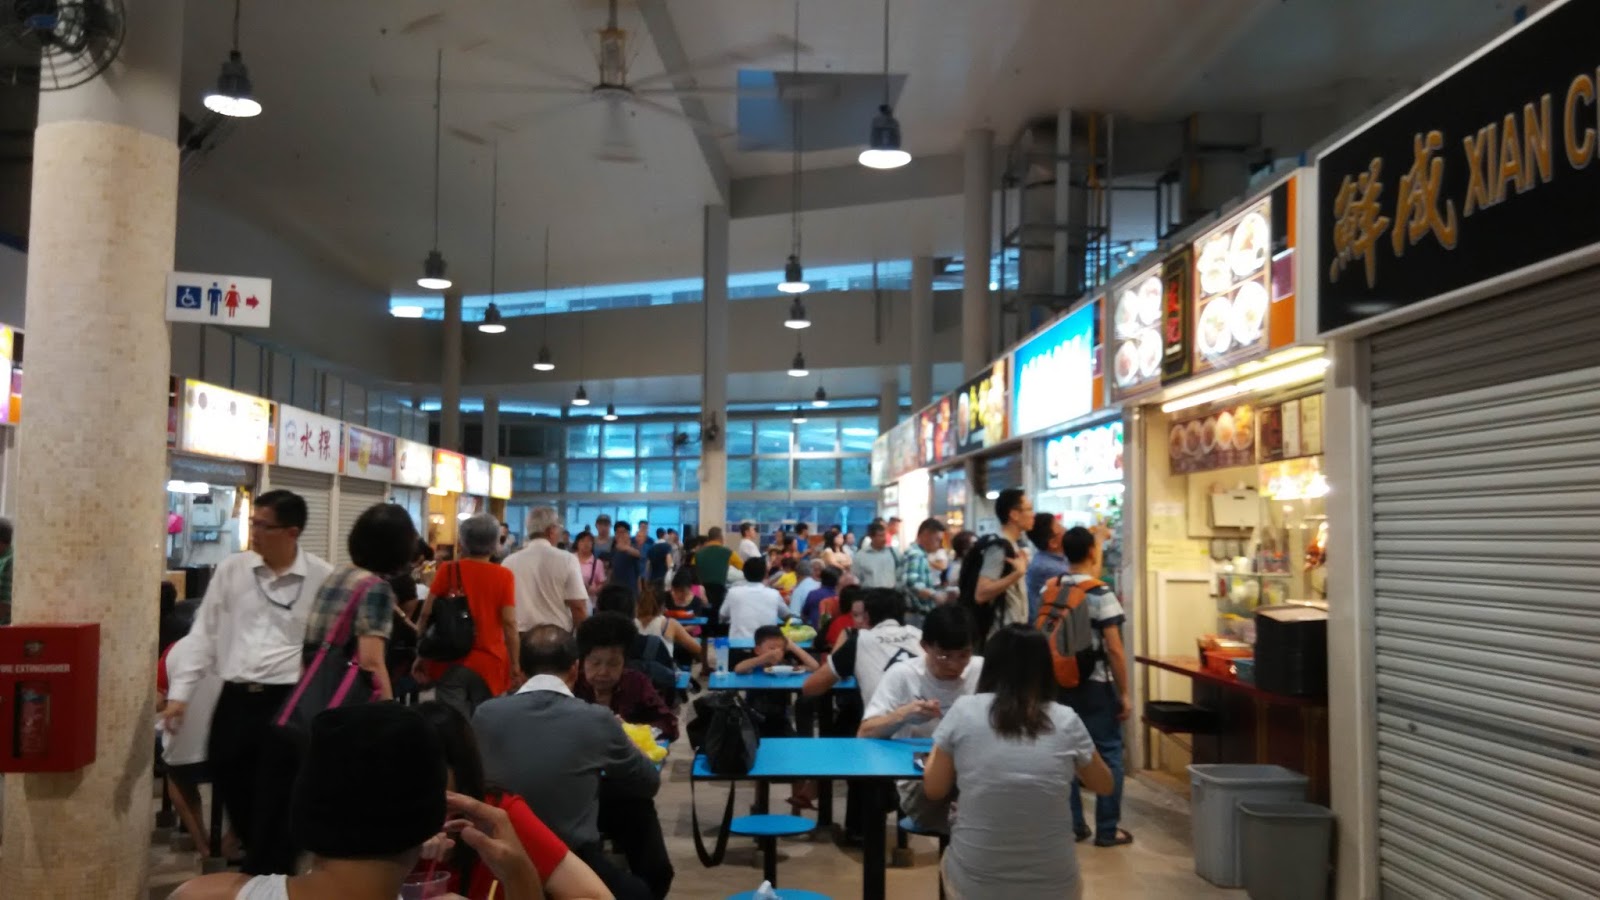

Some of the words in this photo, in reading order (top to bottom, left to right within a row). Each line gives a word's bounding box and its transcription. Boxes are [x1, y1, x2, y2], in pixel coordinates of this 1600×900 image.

[1463, 93, 1551, 218] XIAN
[1563, 65, 1600, 170] C
[0, 664, 13, 673] IRE
[15, 663, 71, 673] EXTINGUISHER
